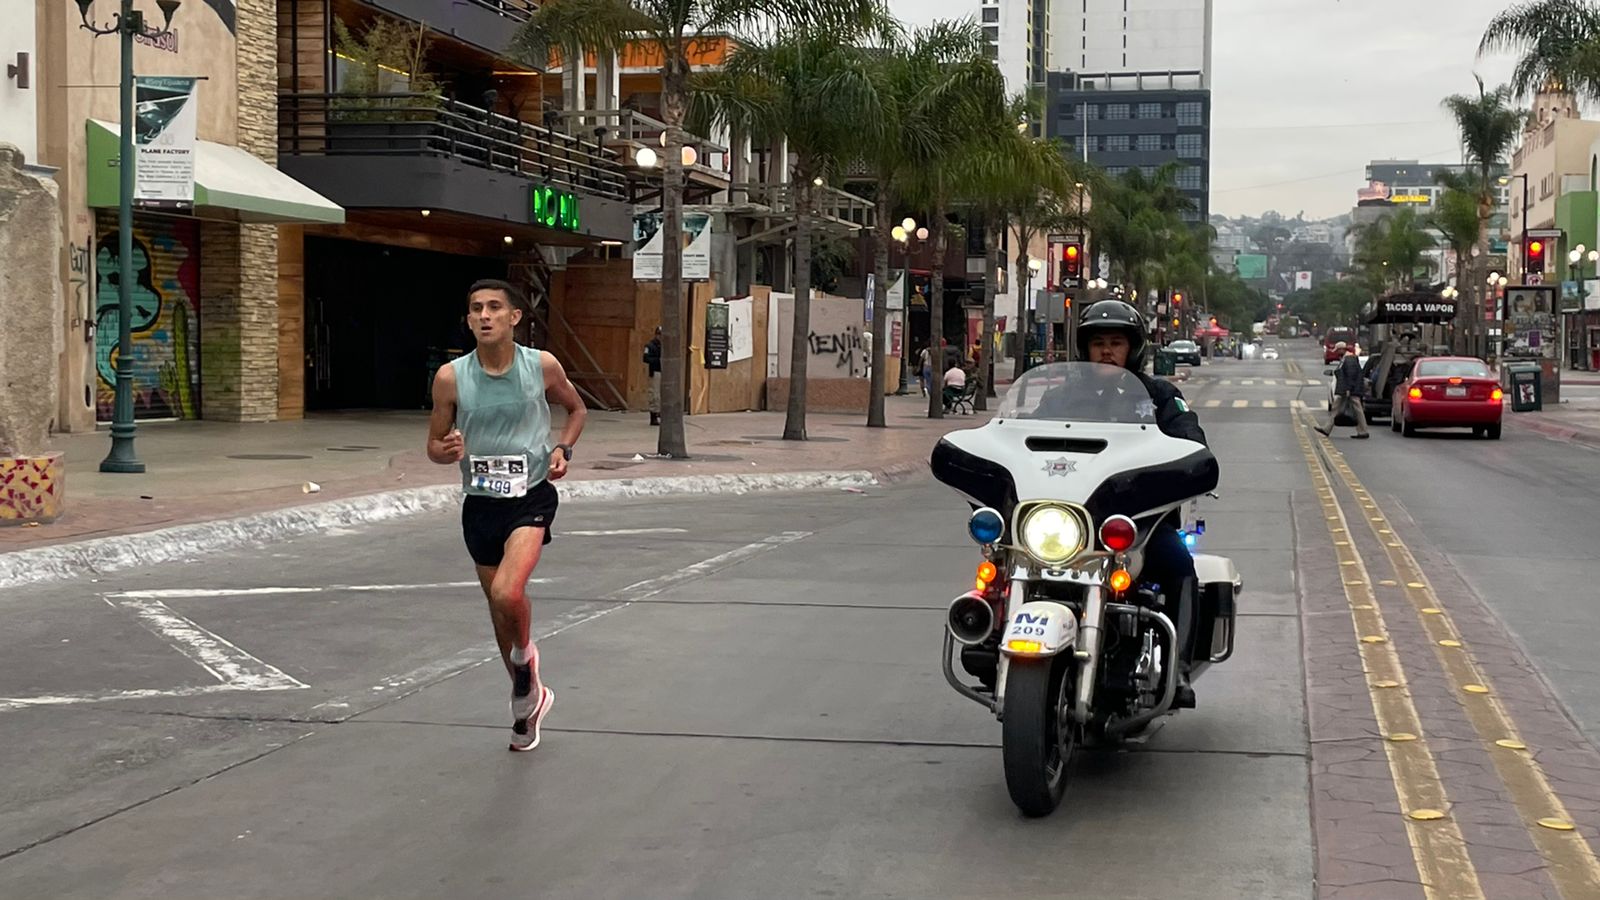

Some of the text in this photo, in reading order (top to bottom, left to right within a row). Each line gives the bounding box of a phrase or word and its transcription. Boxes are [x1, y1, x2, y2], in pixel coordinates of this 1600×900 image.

[1385, 303, 1454, 313] TACOS A VAPOR
[1012, 626, 1045, 636] 209
